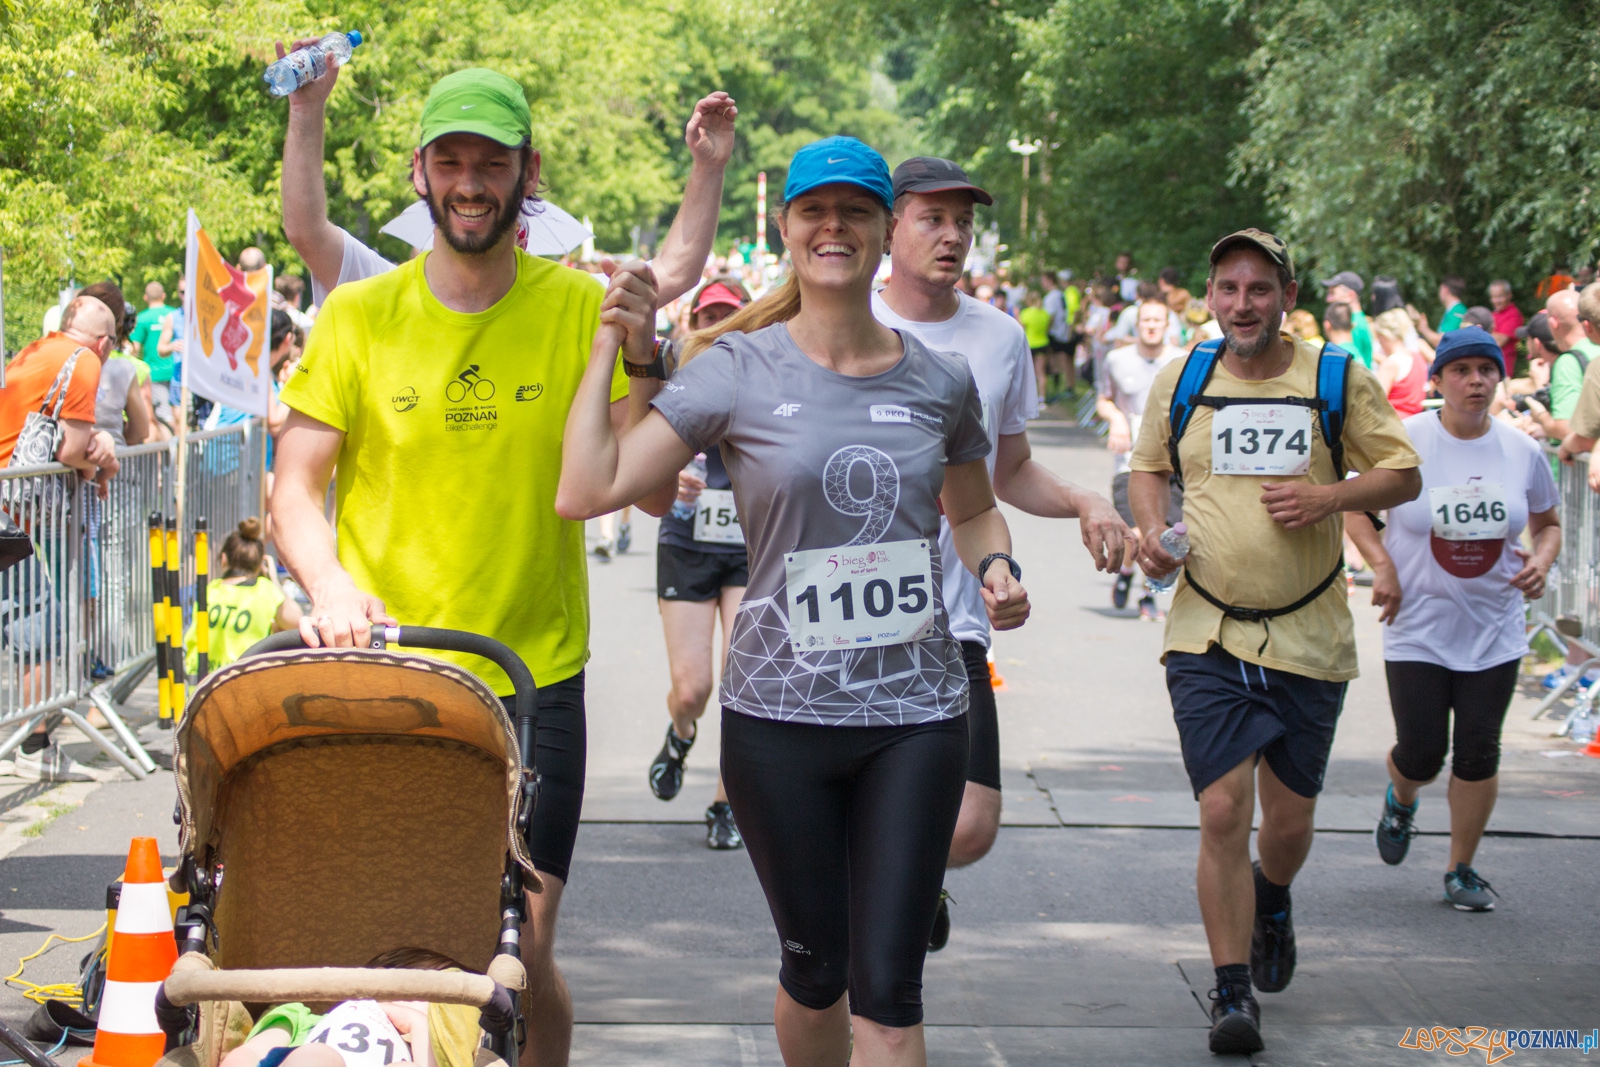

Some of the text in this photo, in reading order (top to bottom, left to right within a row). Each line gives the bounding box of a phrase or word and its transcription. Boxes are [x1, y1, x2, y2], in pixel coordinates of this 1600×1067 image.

[392, 395, 420, 403] UWCT
[773, 403, 801, 417] 4F
[885, 410, 905, 418] PKO
[446, 423, 497, 431] BikeChallenge
[1217, 428, 1308, 455] 1374
[823, 444, 900, 545] 9
[1437, 501, 1506, 525] 1646
[826, 554, 838, 577] 5
[842, 555, 866, 568] bieg
[877, 555, 891, 563] tak
[796, 574, 928, 623] 1105
[208, 604, 251, 633] OTO
